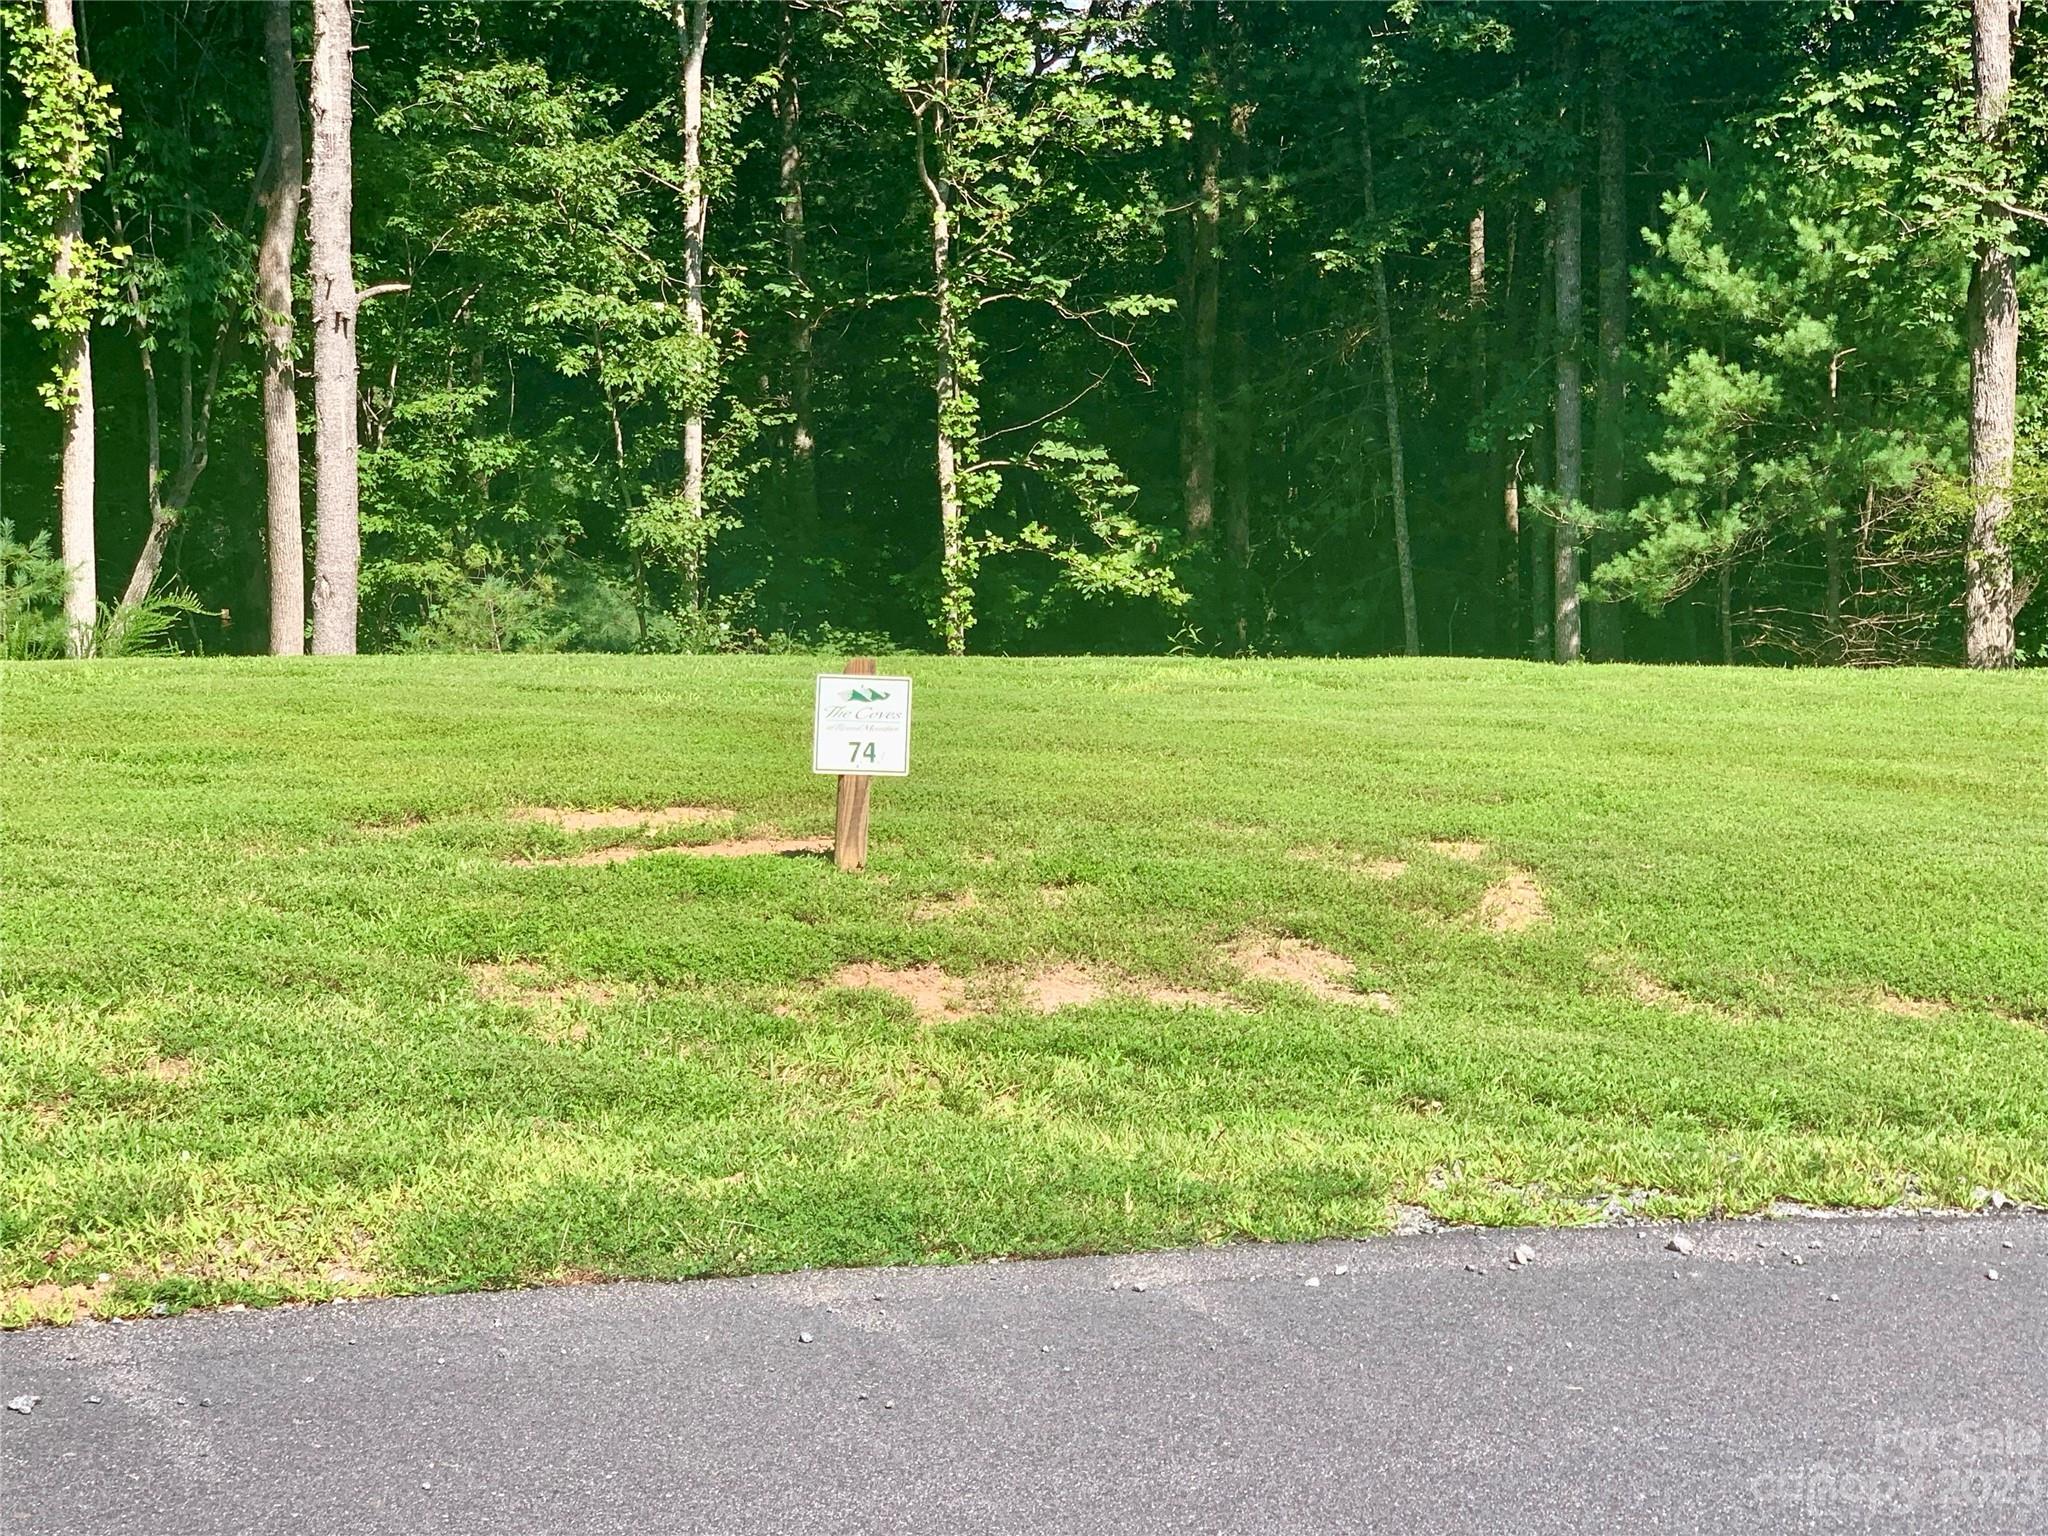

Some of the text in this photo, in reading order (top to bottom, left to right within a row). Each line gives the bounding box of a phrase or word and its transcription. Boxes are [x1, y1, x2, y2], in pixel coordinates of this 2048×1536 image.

[824, 705, 903, 719] The Coves
[848, 741, 876, 763] 74
